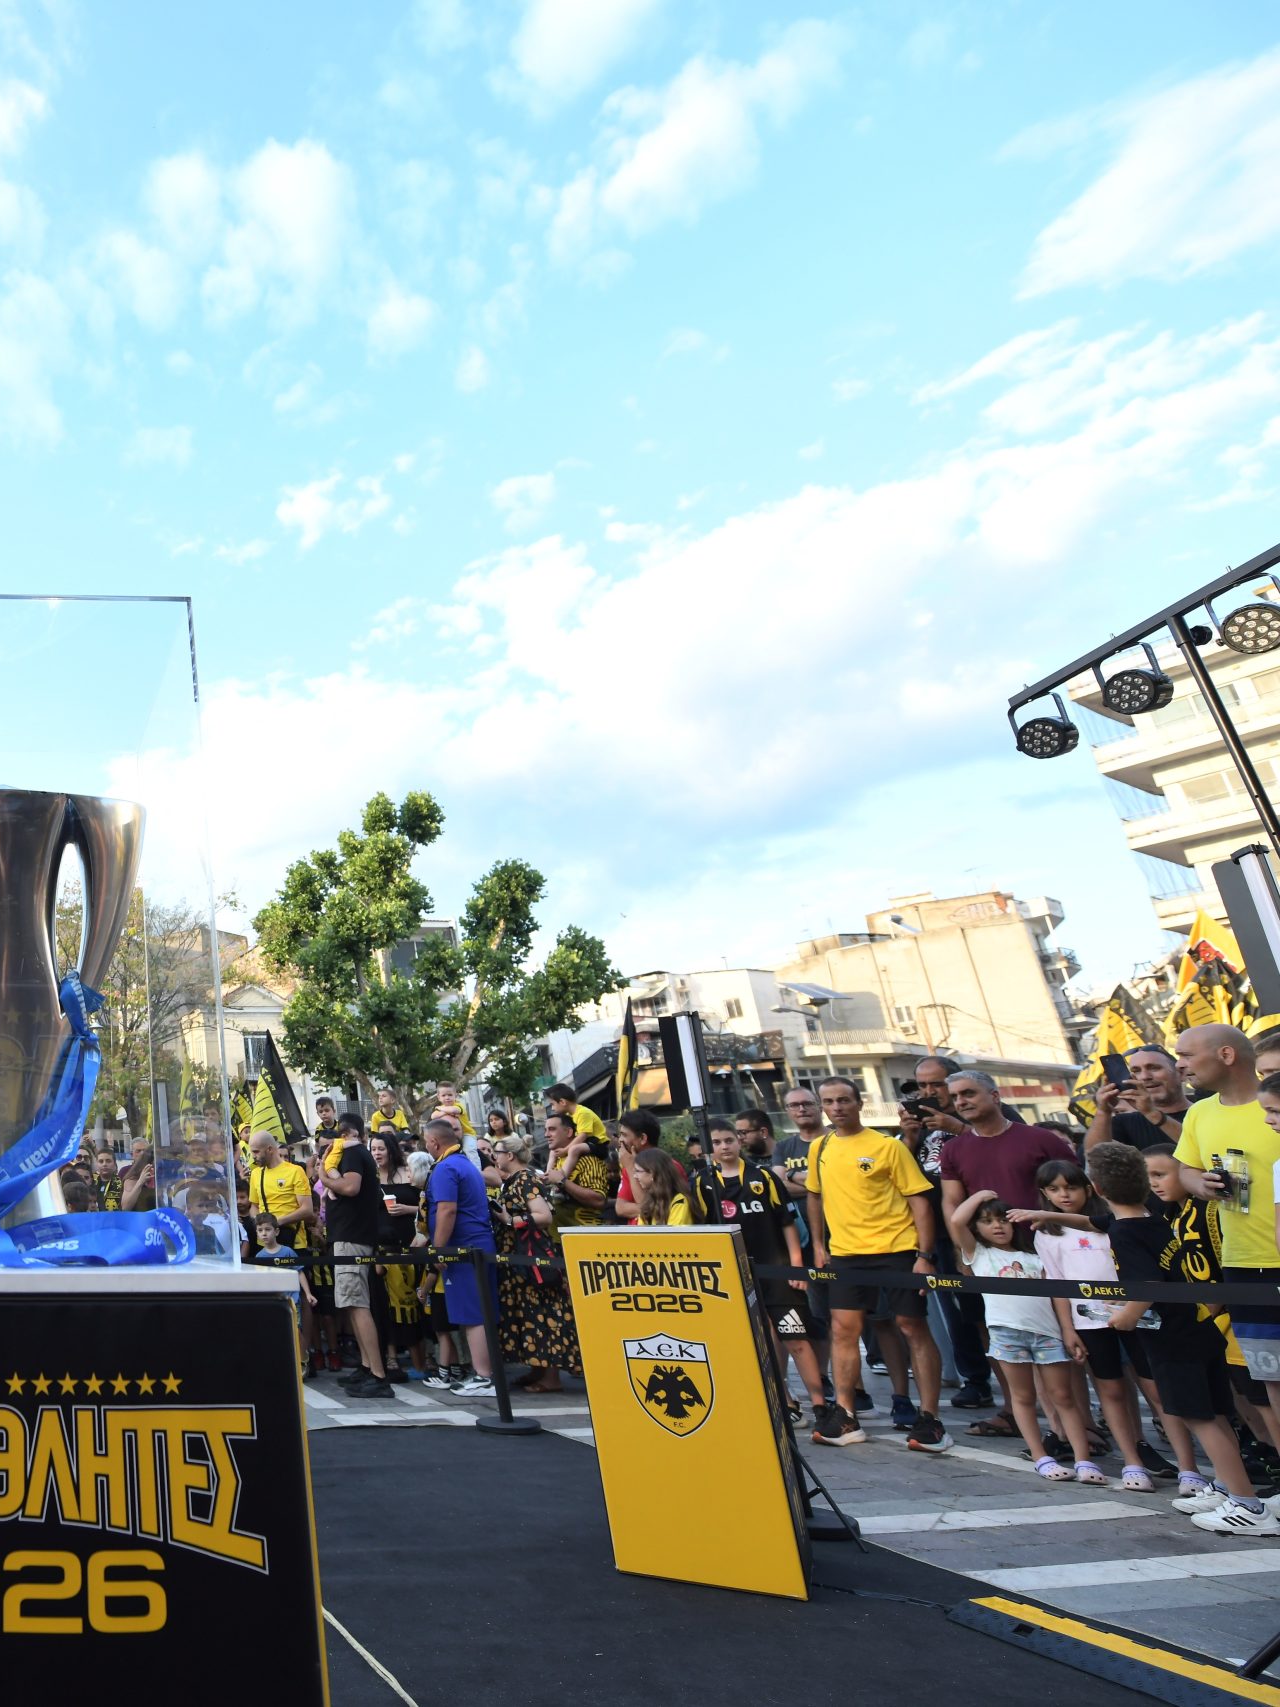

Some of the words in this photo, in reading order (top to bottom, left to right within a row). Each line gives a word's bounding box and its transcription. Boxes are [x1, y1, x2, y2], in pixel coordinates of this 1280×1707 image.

[740, 1200, 765, 1214] LG
[578, 1260, 730, 1300] ΠΡΩΤΑΘΛΗΤΕΣ
[938, 1279, 953, 1287] AEK
[953, 1280, 963, 1288] FC
[1094, 1286, 1113, 1296] AEK
[1113, 1287, 1126, 1297] FC
[610, 1293, 703, 1313] 2026
[777, 1324, 806, 1334] adidas
